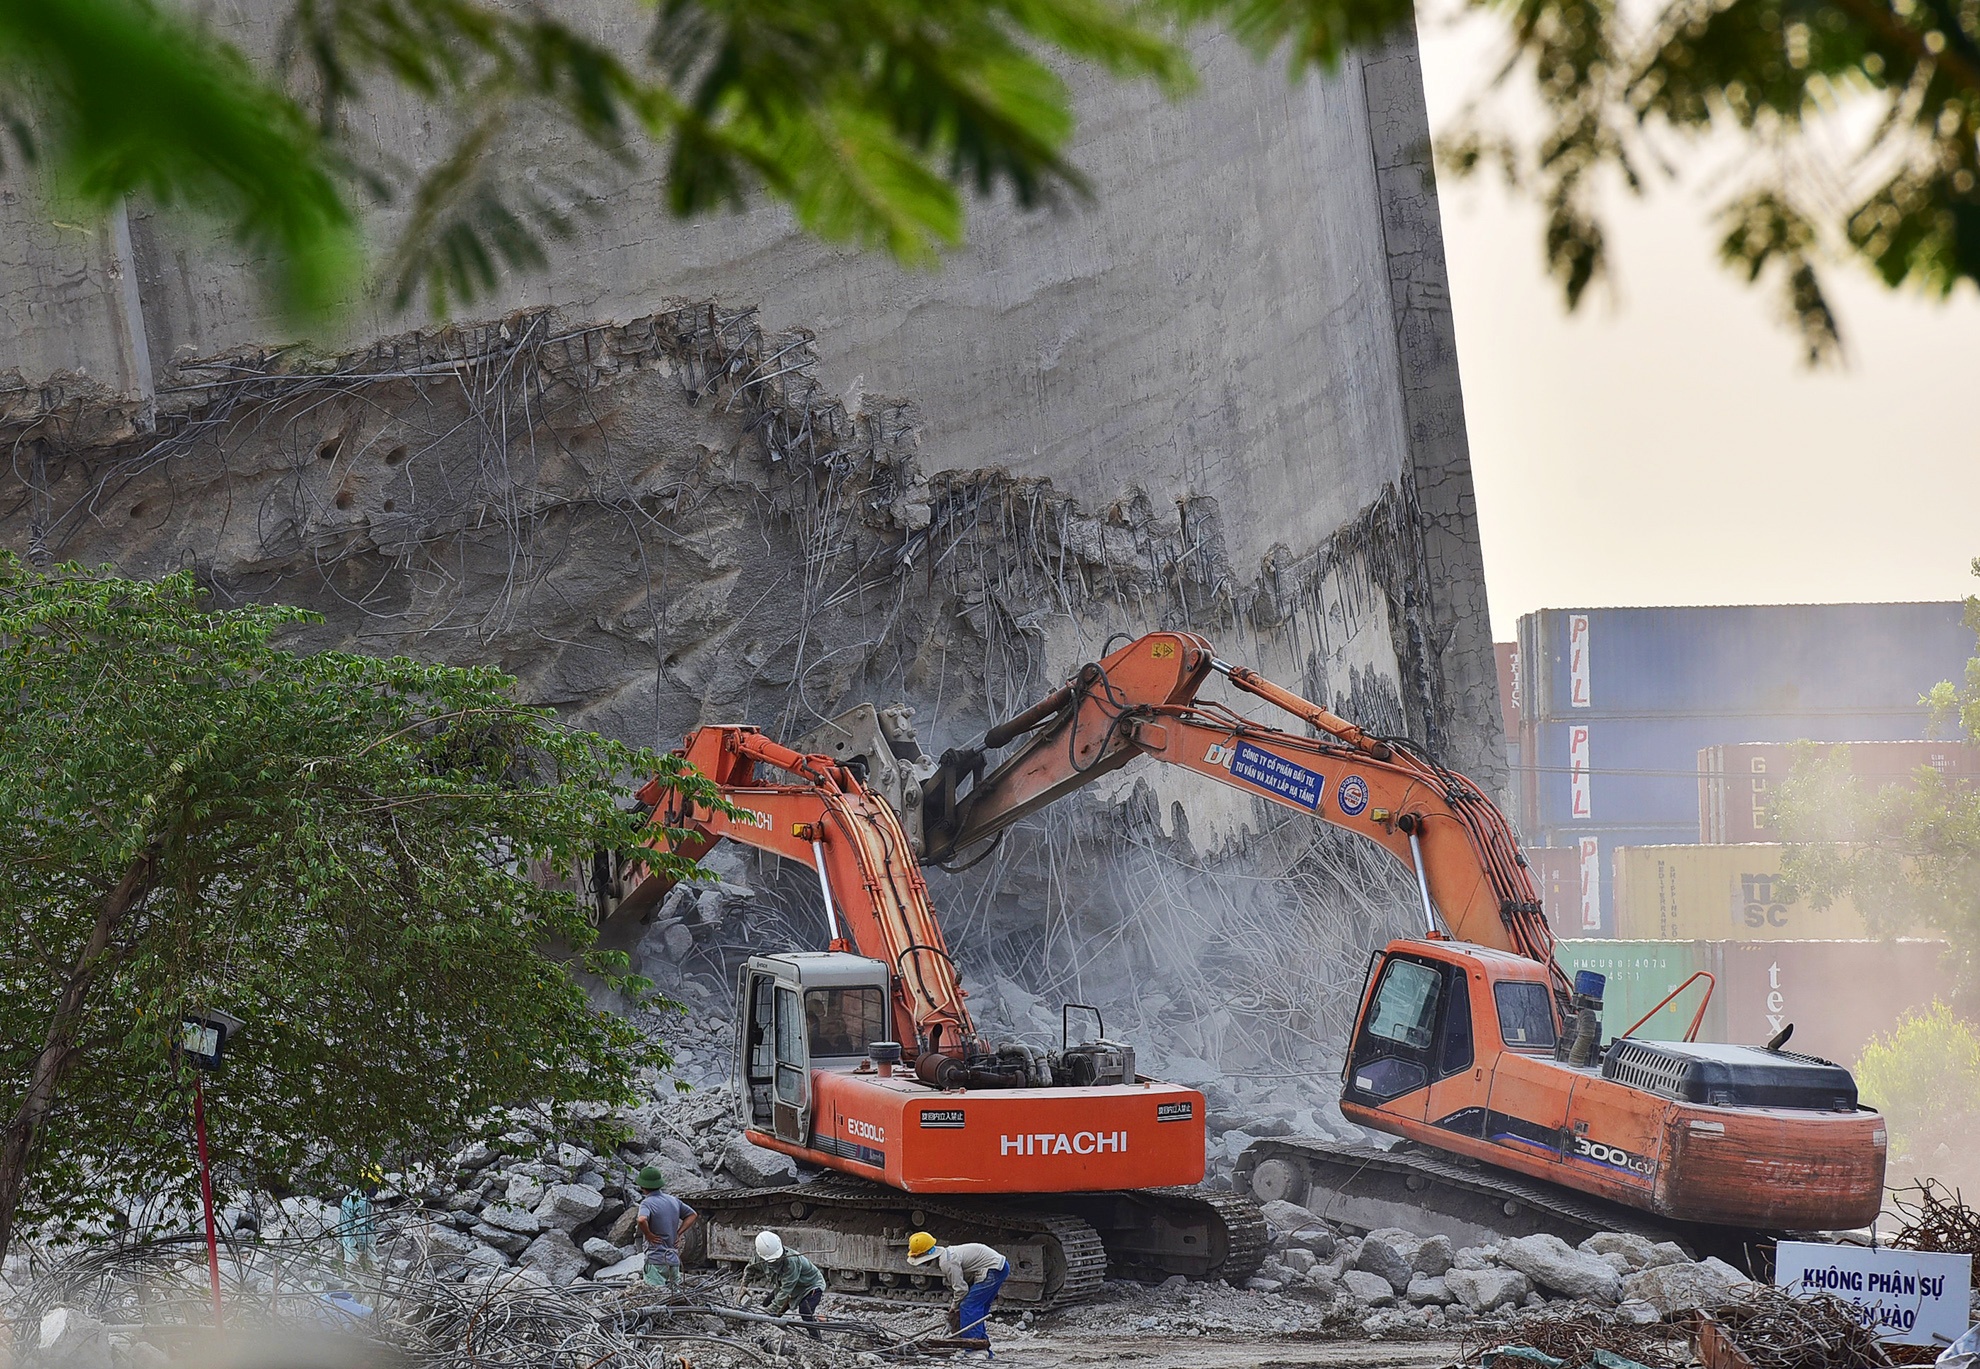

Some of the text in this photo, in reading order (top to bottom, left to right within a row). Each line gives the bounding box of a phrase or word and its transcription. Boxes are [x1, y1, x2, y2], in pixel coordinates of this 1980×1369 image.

[1571, 618, 1588, 703] PIL
[1242, 747, 1259, 763] CÔNG
[1259, 755, 1268, 767] TY
[1571, 729, 1588, 815] PIL
[1235, 761, 1245, 773] TƯ
[1256, 770, 1265, 782] VÀ
[1288, 785, 1298, 798] HẠ
[1581, 840, 1597, 926] PIL
[1657, 860, 1667, 939] MEDITERRANEA
[1765, 961, 1785, 1036] tex
[847, 1118, 885, 1144] EX300LC
[1000, 1131, 1127, 1156] HITACHI
[1803, 1265, 1946, 1301] KHÔNG PHẬN SỰ
[1880, 1304, 1915, 1329] VÀO
